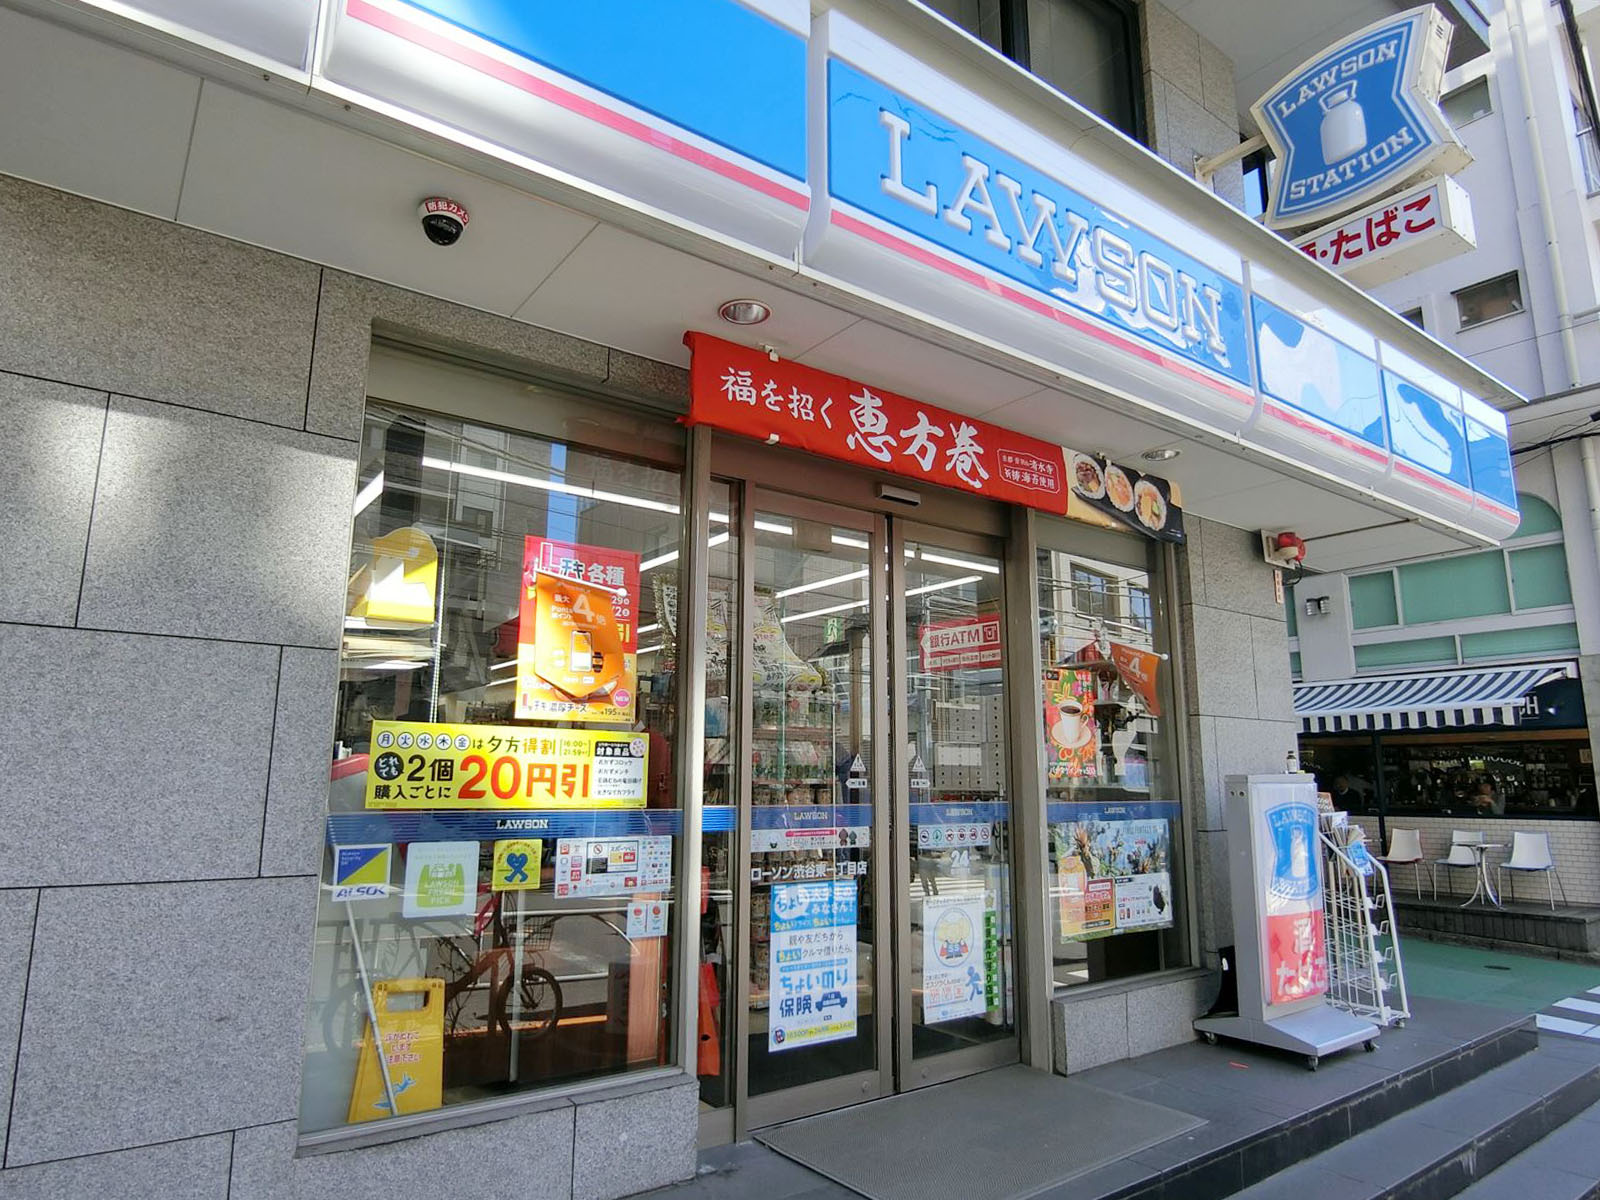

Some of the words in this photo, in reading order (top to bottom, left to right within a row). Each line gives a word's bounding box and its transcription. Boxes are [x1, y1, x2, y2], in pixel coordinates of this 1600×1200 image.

[1278, 40, 1397, 117] LAWSON
[1290, 127, 1414, 199] STATION
[880, 108, 1227, 357] LAWSON
[720, 367, 833, 429] 福を招く
[846, 388, 989, 489] 恵方巻
[573, 594, 595, 623] 4
[929, 629, 980, 649] 銀行ATM
[457, 754, 589, 800] 20円引
[374, 785, 452, 800] 購入ごとに
[496, 819, 548, 829] LAWSON
[951, 850, 969, 867] 24
[780, 994, 812, 1018] 保険
